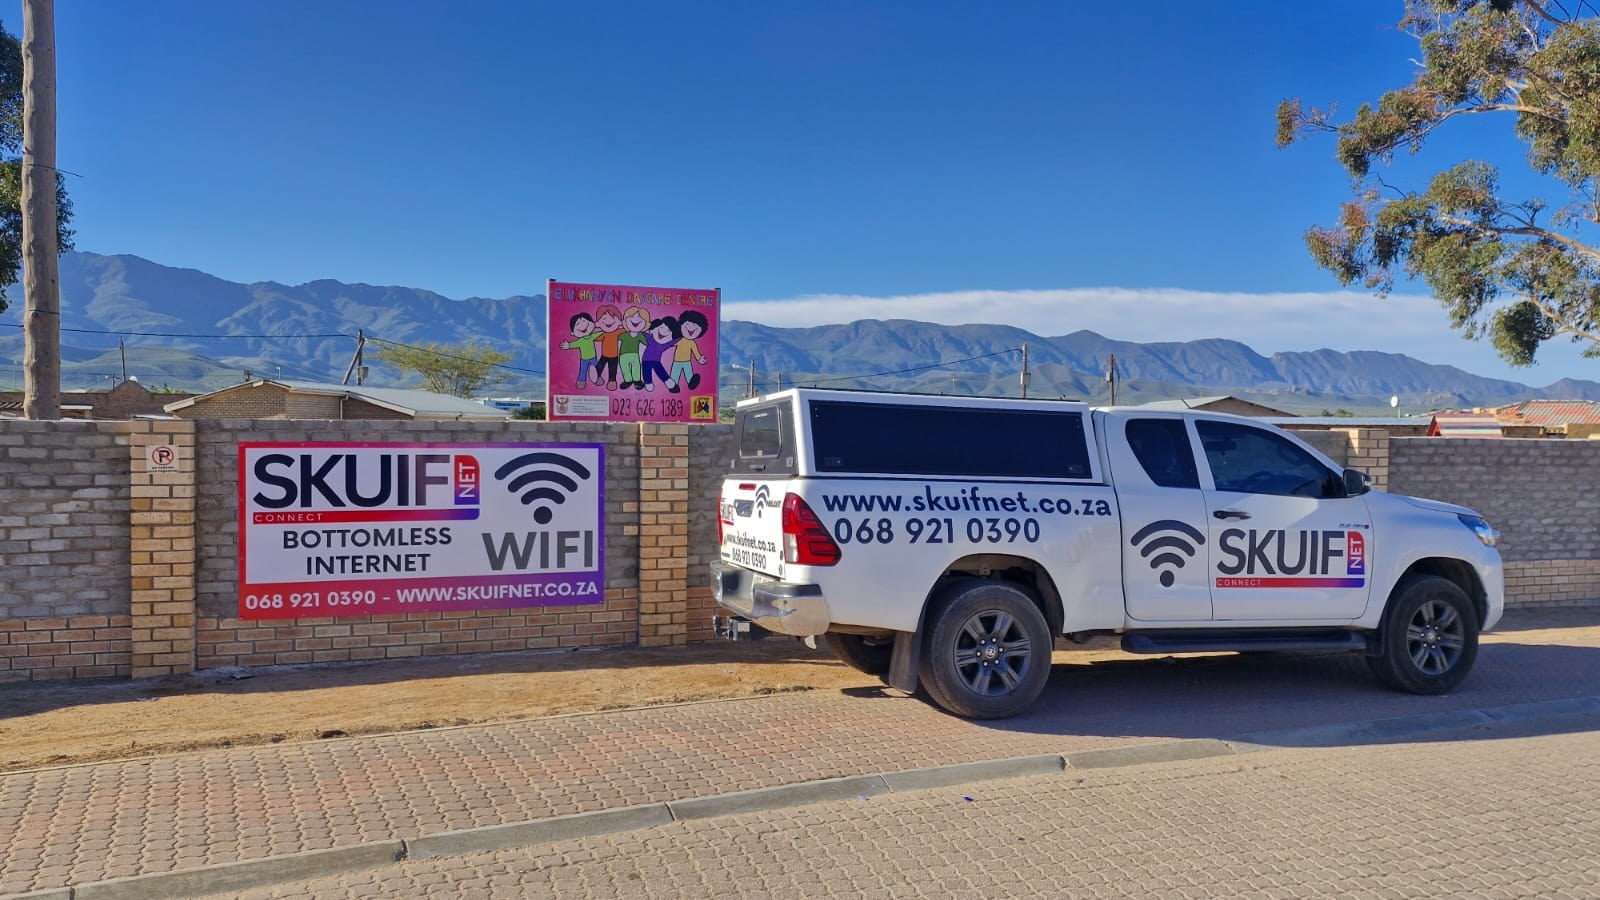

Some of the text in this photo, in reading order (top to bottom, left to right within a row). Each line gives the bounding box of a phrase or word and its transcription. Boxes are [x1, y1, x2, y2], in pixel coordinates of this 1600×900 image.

[676, 293, 714, 307] CENTRE
[612, 398, 631, 417] 023
[636, 398, 655, 417] 626
[661, 398, 683, 417] 1389
[253, 453, 450, 509] SKUIF
[459, 462, 476, 498] NET
[822, 485, 1112, 517] www.skuifnet.co.za
[254, 513, 323, 523] CONNECT
[834, 518, 1040, 544] 068 921 0390
[283, 527, 452, 549] BOTTOMLESS
[482, 530, 593, 571] WIFI
[1216, 528, 1345, 575] SKUIF
[306, 553, 431, 575] INTERNET
[751, 552, 766, 569] 0390
[1350, 538, 1362, 569] NET
[246, 594, 284, 610] 068
[290, 593, 320, 608] 921
[327, 590, 376, 606] 0390
[396, 581, 598, 603] WWW.SKUIFNET.CO.ZA
